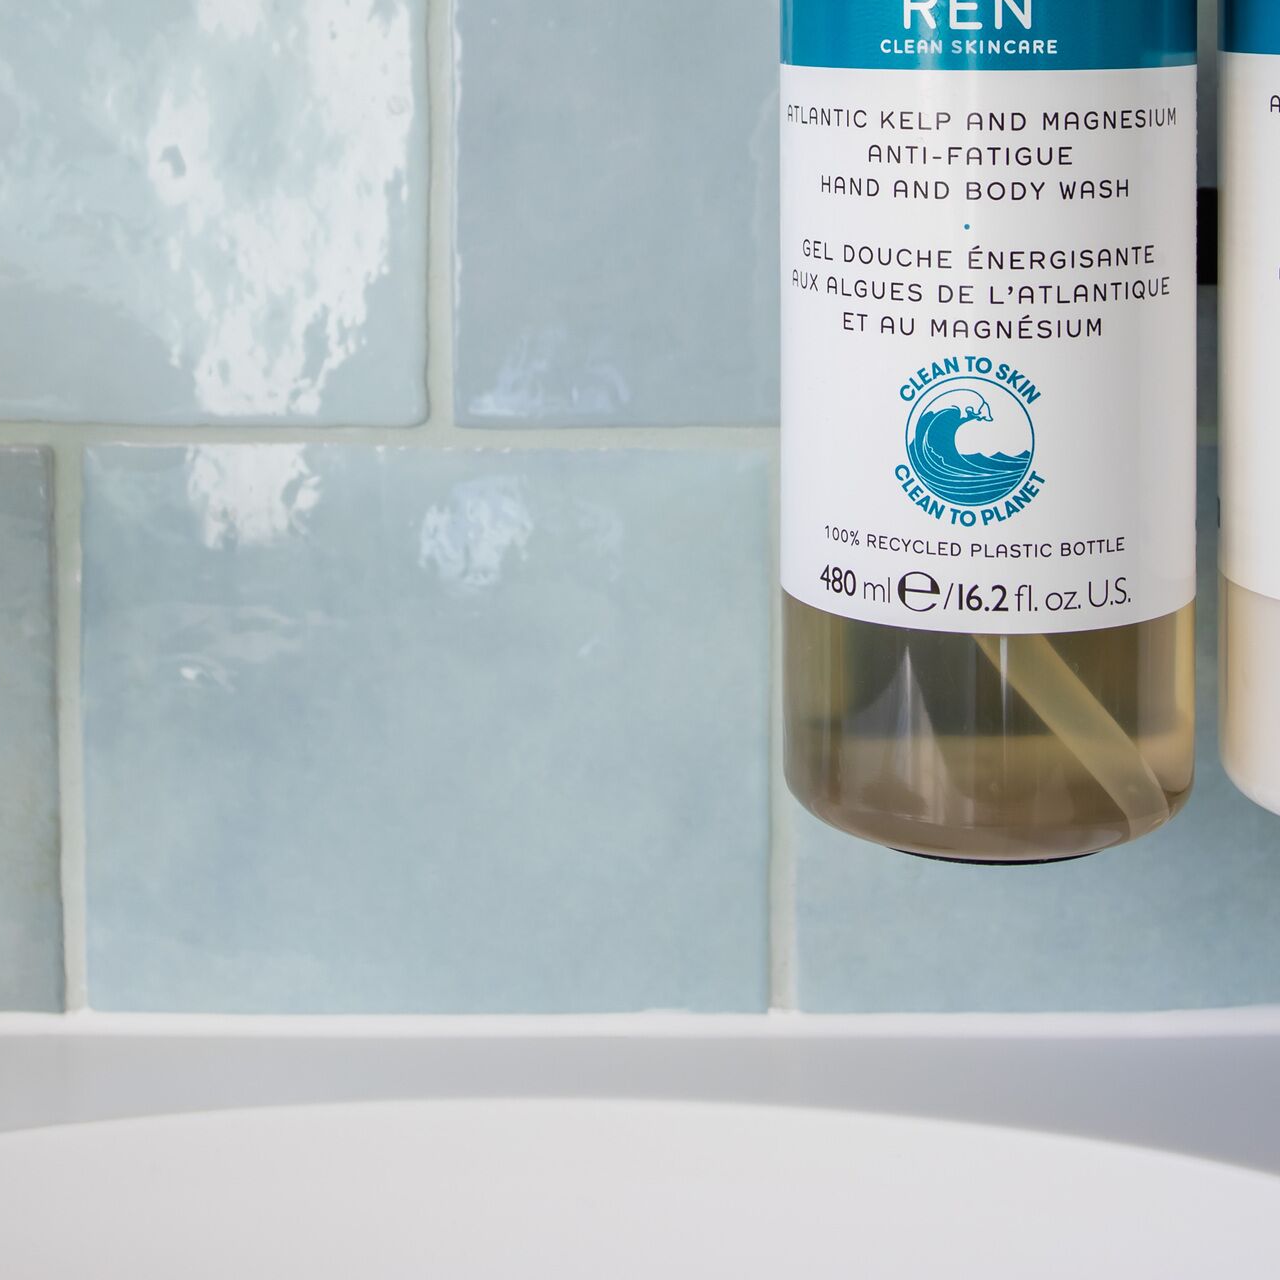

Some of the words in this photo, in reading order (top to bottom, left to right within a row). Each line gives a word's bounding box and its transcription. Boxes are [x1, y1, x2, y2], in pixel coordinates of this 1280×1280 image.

[880, 39, 943, 55] CLEAN
[951, 39, 1058, 55] SKINCARE
[788, 105, 867, 128] ATLANTIC
[881, 111, 951, 130] KELP
[967, 112, 1026, 131] AND
[1043, 107, 1176, 130] MAGNESIUM
[869, 144, 1072, 166] ANTI-FATIGUE
[822, 175, 879, 197] HAND
[894, 180, 949, 199] AND
[966, 182, 1045, 200] BODY
[1059, 179, 1128, 200] WASH
[803, 239, 833, 261] GEL
[844, 244, 952, 269] DOUCHE
[968, 245, 1154, 270] ÉNERGISANTE
[793, 269, 818, 292] AUX
[827, 276, 922, 302] ALGUES
[939, 285, 973, 304] DE
[990, 276, 1169, 304] L’ATLANTIQUE
[843, 312, 868, 332] ET
[881, 316, 914, 336] AU
[931, 315, 1101, 339] MAGNÉSIUM
[899, 356, 960, 403] CLEAN
[964, 355, 993, 375] TO
[995, 362, 1041, 406] SKIN
[894, 463, 947, 519] CLEAN
[950, 508, 977, 528] TO
[980, 469, 1046, 527] PLANET
[825, 525, 859, 546] 100%
[867, 534, 961, 556] RECYCLED
[971, 543, 1052, 558] PLASTIC
[1061, 537, 1125, 556] BOTTLE
[820, 564, 856, 596] 480
[864, 577, 890, 603] ml
[1014, 585, 1038, 612] fl.
[1045, 591, 1081, 611] oz.
[1089, 577, 1131, 607] U.S.
